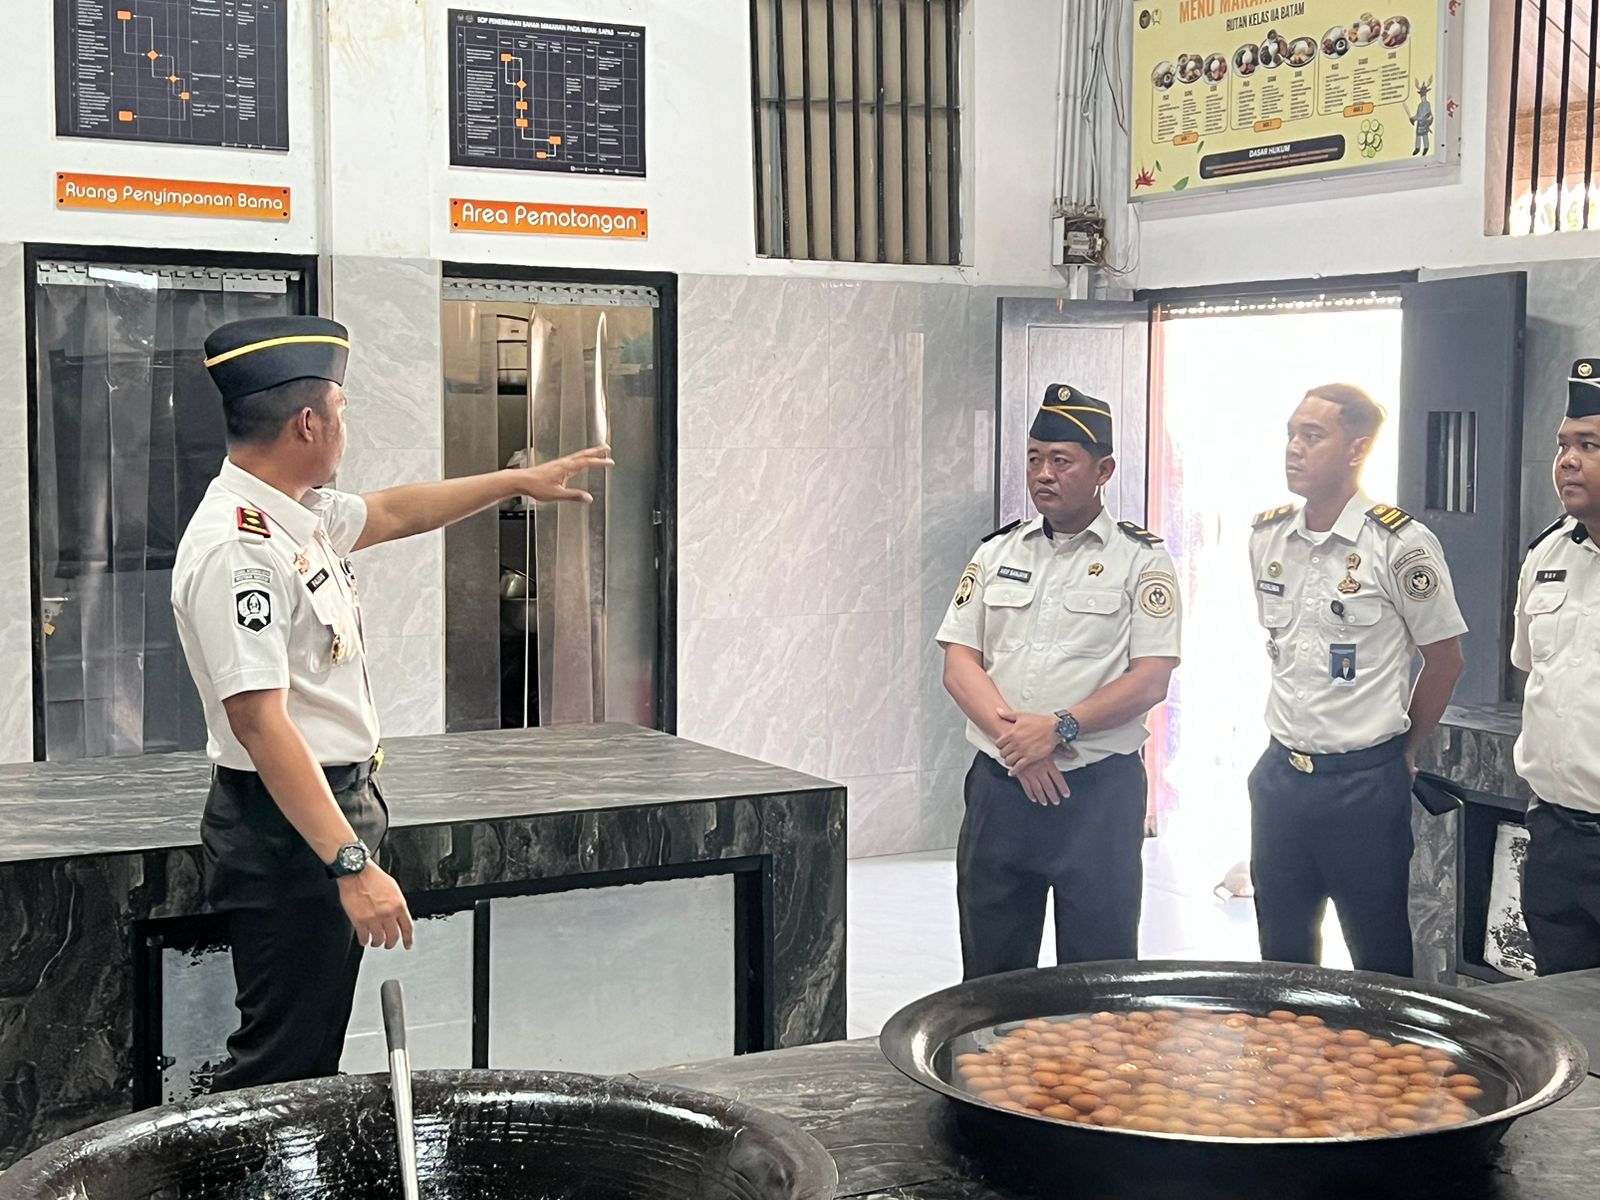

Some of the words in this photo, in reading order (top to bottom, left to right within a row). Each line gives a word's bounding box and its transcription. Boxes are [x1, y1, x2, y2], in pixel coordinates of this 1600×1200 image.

[1179, 0, 1215, 24] MENU
[1248, 10, 1269, 26] KELAS
[1280, 2, 1305, 20] BATAM
[1249, 148, 1268, 158] DASAR
[1268, 144, 1291, 155] HUKUM
[65, 181, 118, 203] Ruang
[122, 185, 234, 208] Penyimpanan
[238, 192, 283, 210] Bama
[462, 202, 508, 224] Area
[515, 205, 637, 233] Pemotongan
